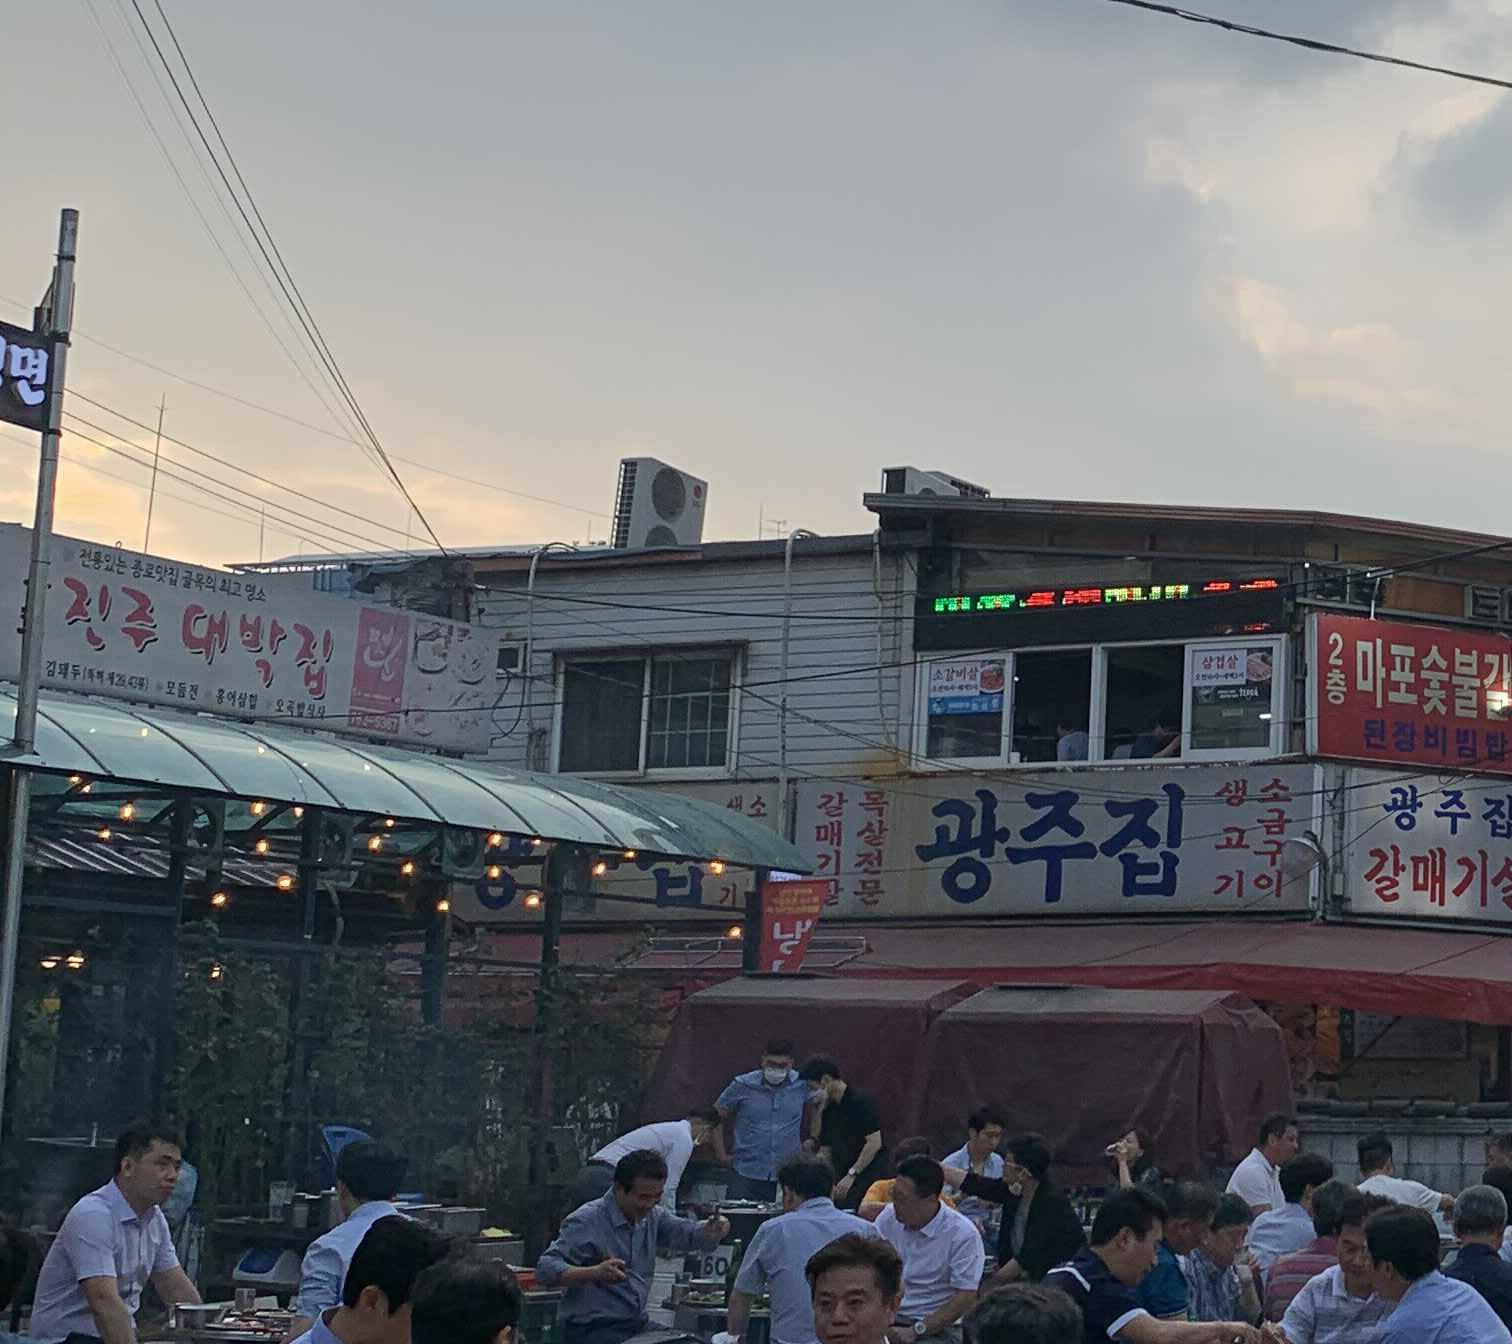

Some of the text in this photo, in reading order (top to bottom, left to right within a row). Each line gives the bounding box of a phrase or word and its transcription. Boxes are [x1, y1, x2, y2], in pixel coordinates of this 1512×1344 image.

[0, 335, 48, 405] 면
[63, 576, 159, 654] 진주
[182, 603, 334, 701] 대박집
[915, 782, 1185, 904] 광주집
